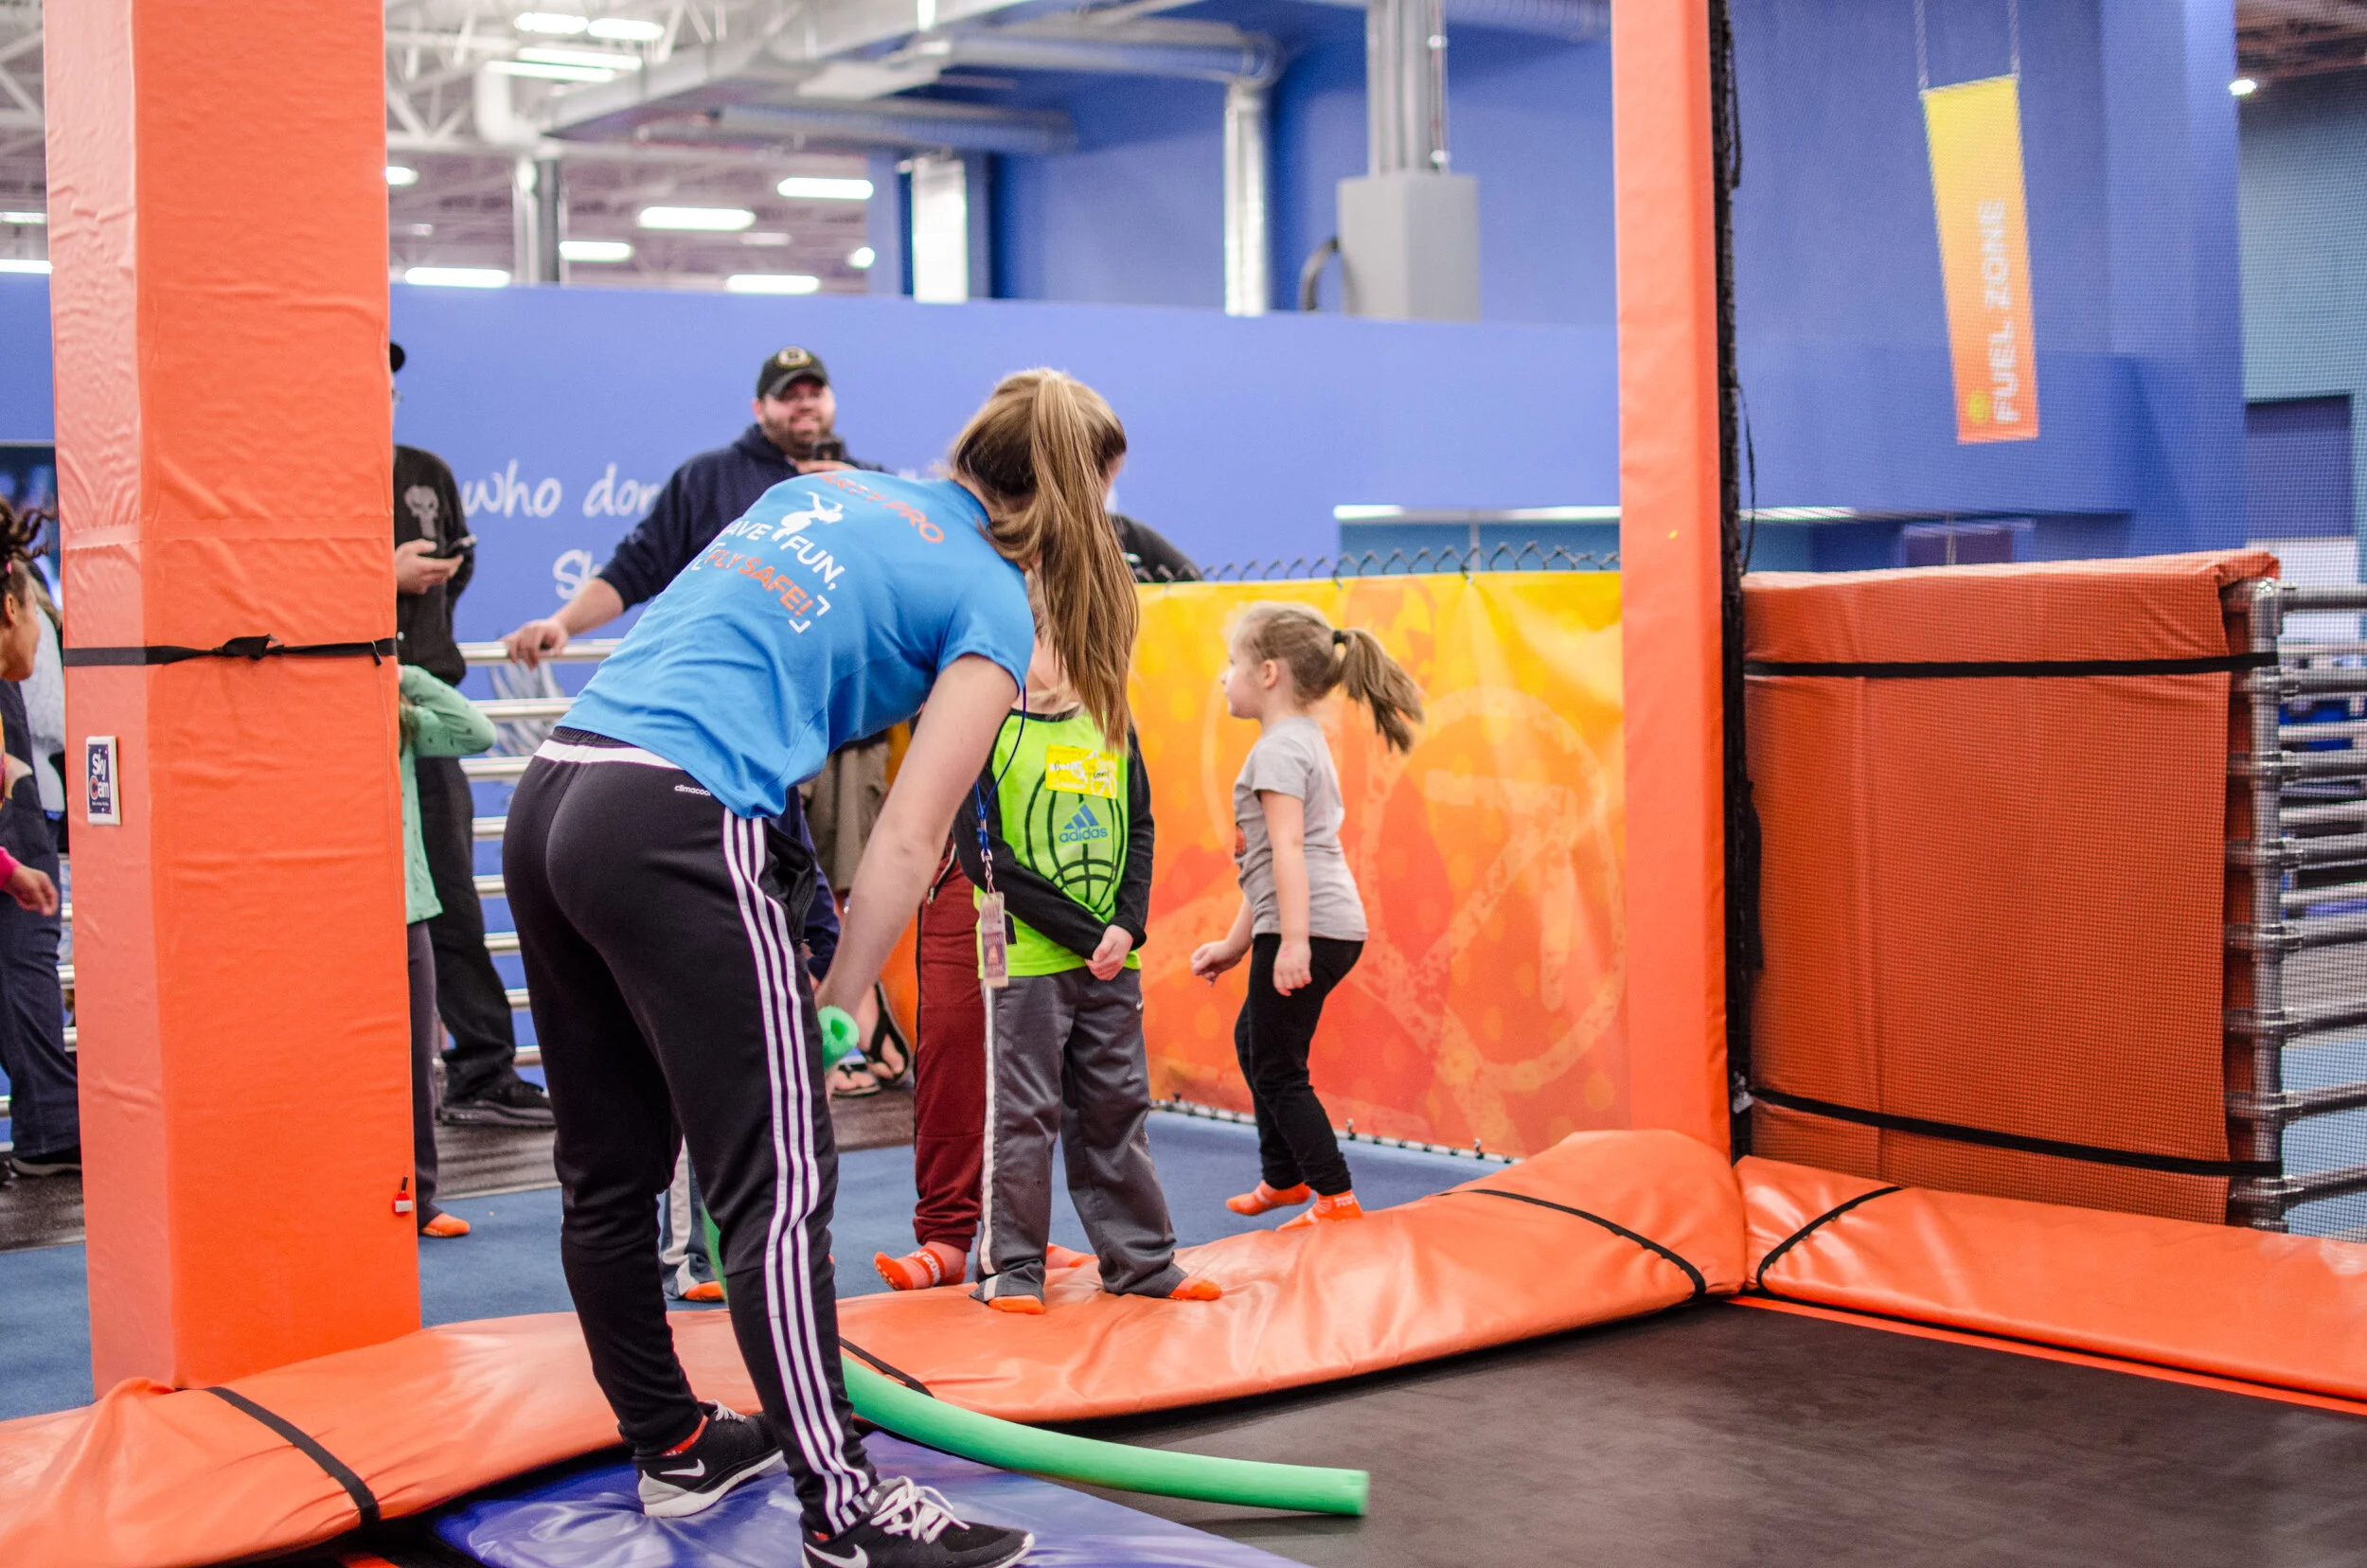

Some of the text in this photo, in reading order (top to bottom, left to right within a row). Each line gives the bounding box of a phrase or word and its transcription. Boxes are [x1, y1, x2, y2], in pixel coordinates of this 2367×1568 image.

[1979, 198, 2020, 424] FUEL ZONE
[461, 458, 562, 518] who
[881, 500, 944, 543] PRO
[722, 520, 845, 591] AVE FUN,
[704, 547, 813, 616] FLY SAFE!
[90, 775, 110, 800] Cam
[92, 748, 107, 780] Sky
[1059, 827, 1108, 844] adidas
